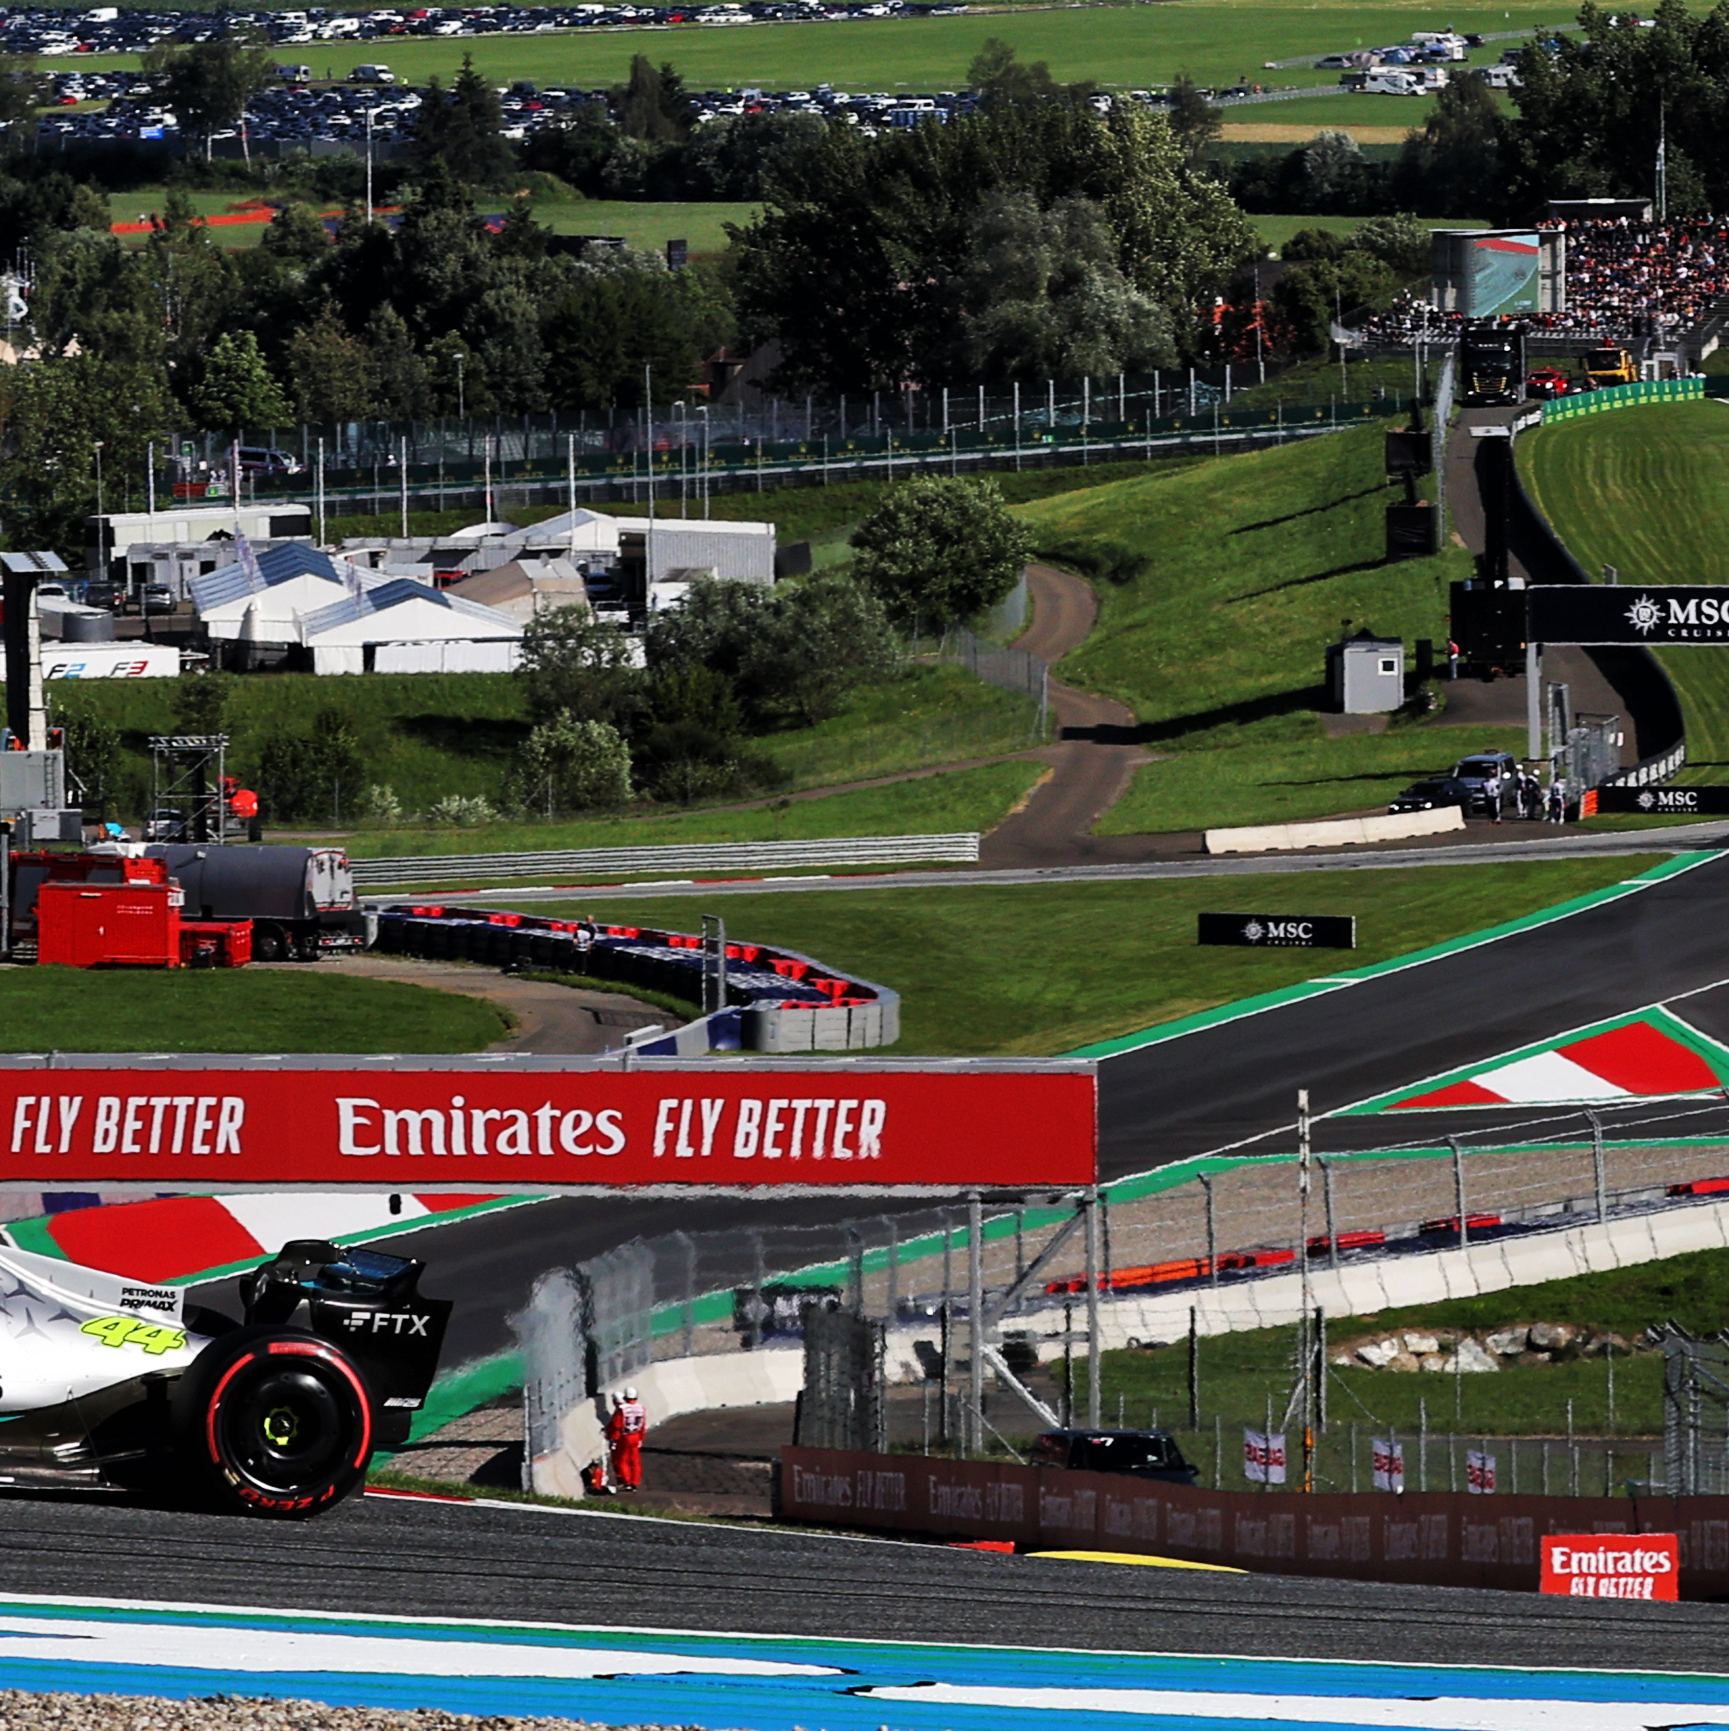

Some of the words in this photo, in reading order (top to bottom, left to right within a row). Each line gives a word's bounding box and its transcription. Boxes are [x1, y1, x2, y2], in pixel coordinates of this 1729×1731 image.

[47, 663, 87, 679] F2
[110, 660, 149, 676] F3
[1658, 791, 1697, 805] MSC
[1267, 922, 1313, 939] MSC
[10, 1095, 83, 1154] FLY
[92, 1095, 245, 1155] BETTER
[335, 1095, 626, 1156] Emirates
[653, 1098, 725, 1158] FLY
[733, 1098, 886, 1160] BETTER
[121, 1287, 177, 1301] PETRONAS
[119, 1299, 178, 1313] PRIMAX
[372, 1313, 431, 1337] FTX
[80, 1315, 187, 1355] 44
[1551, 1545, 1672, 1574] Emirates
